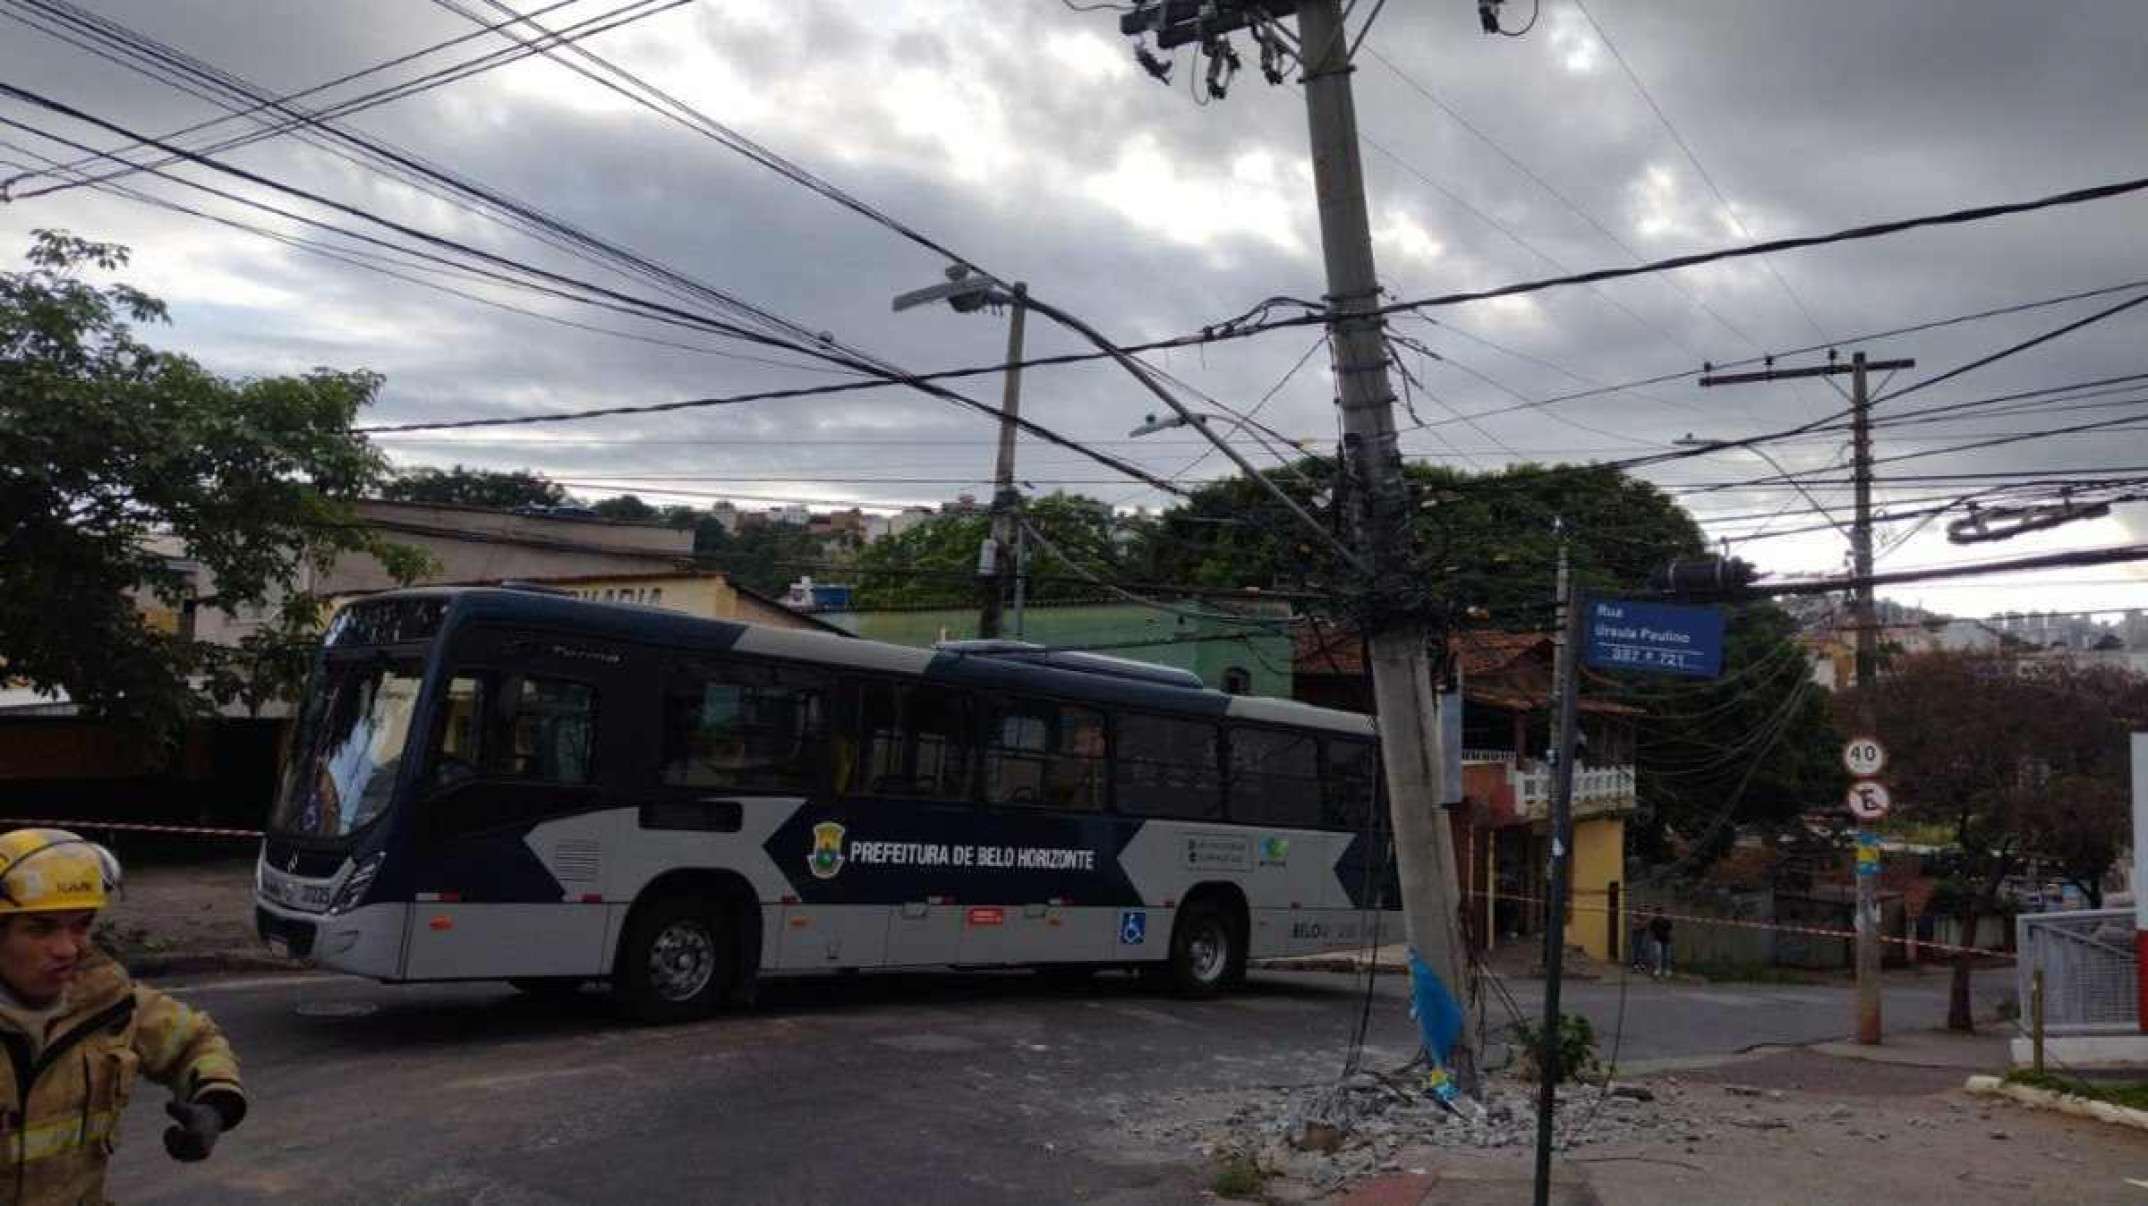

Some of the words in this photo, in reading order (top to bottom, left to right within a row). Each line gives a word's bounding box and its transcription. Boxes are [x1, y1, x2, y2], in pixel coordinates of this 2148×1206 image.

[1597, 604, 1623, 618] Rua
[1640, 627, 1691, 643] Paulino
[1850, 746, 1876, 761] 40
[849, 840, 949, 866] PREFEITURA
[953, 845, 973, 866] DE
[977, 846, 1014, 868] BELO
[1017, 848, 1096, 870] HORIZONTE
